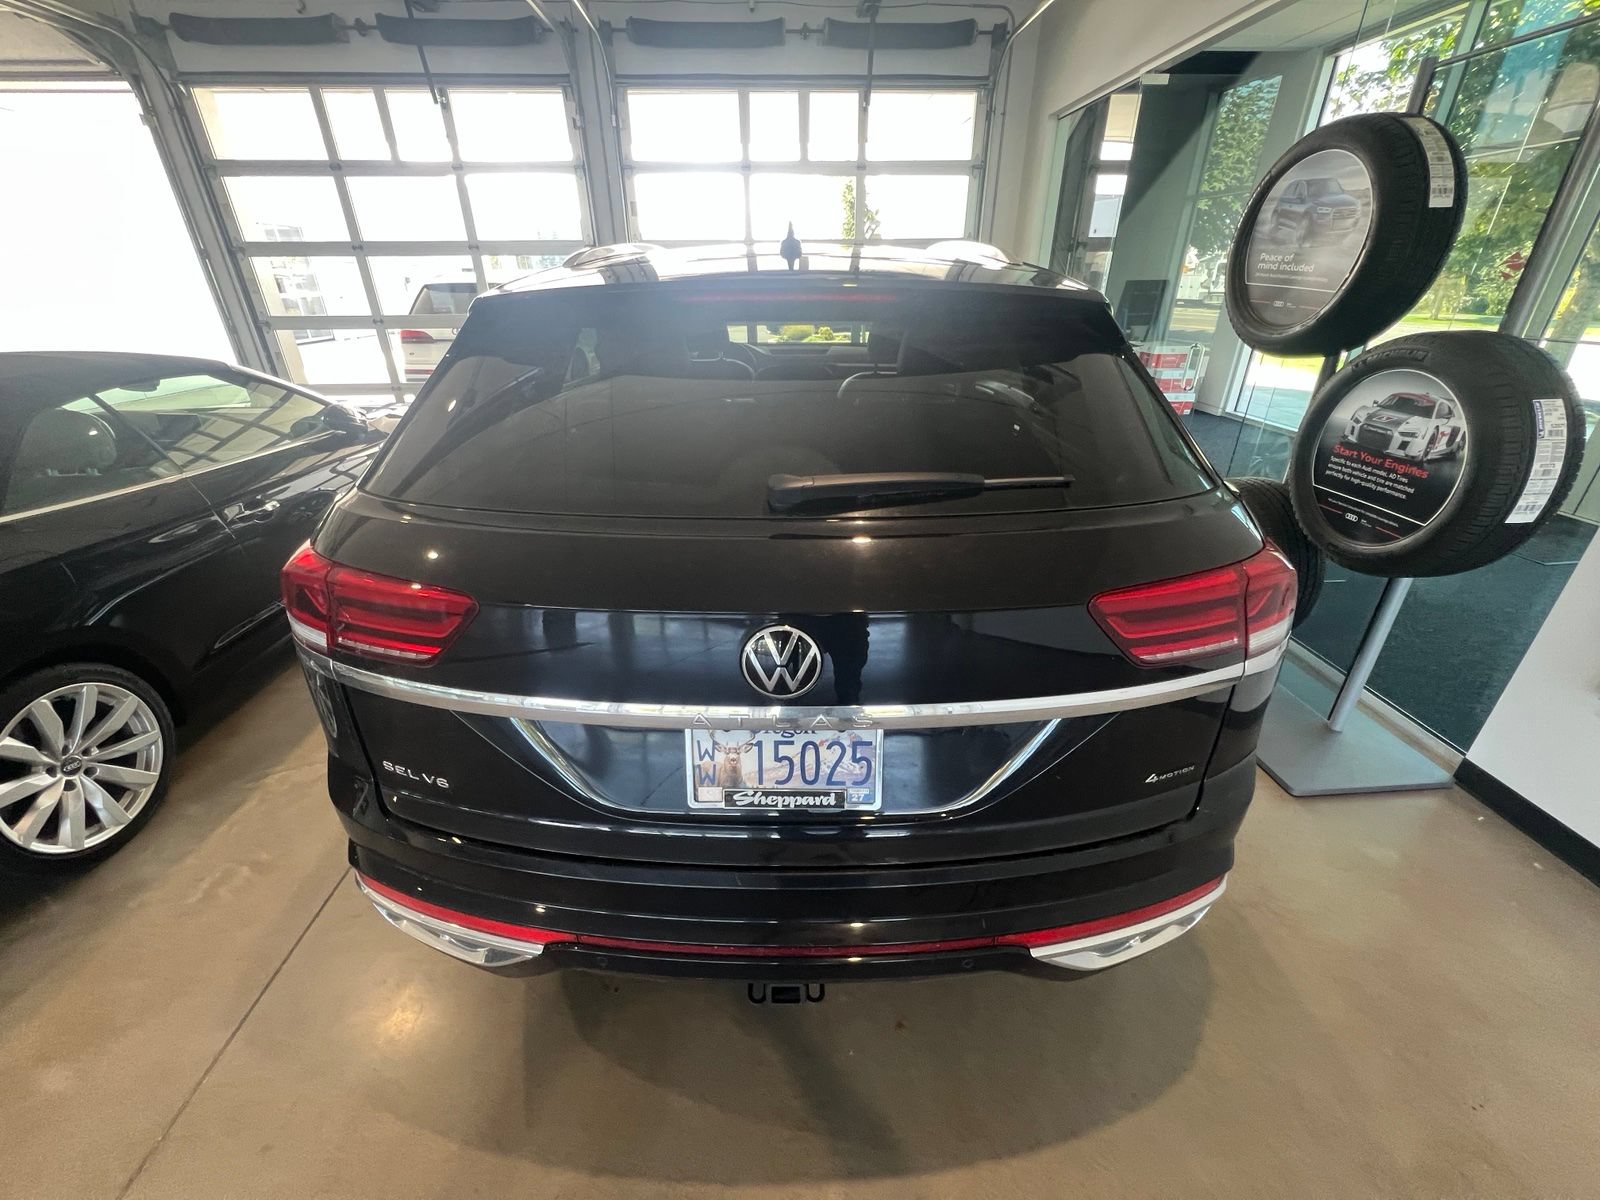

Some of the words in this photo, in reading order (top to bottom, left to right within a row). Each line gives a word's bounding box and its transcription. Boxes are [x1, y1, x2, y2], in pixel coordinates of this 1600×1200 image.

[1260, 252, 1283, 262] Peace
[1283, 252, 1295, 262] of
[1257, 262, 1279, 271] mind
[1279, 262, 1315, 273] included
[1333, 445, 1358, 458] Start
[1359, 452, 1383, 465] Your
[1384, 458, 1430, 479] Engines
[690, 712, 875, 729] ATLAS
[753, 740, 873, 786] 15025
[382, 760, 420, 781] SEL
[421, 772, 450, 789] V6
[732, 790, 837, 809] Sheppard
[851, 793, 866, 803] 27
